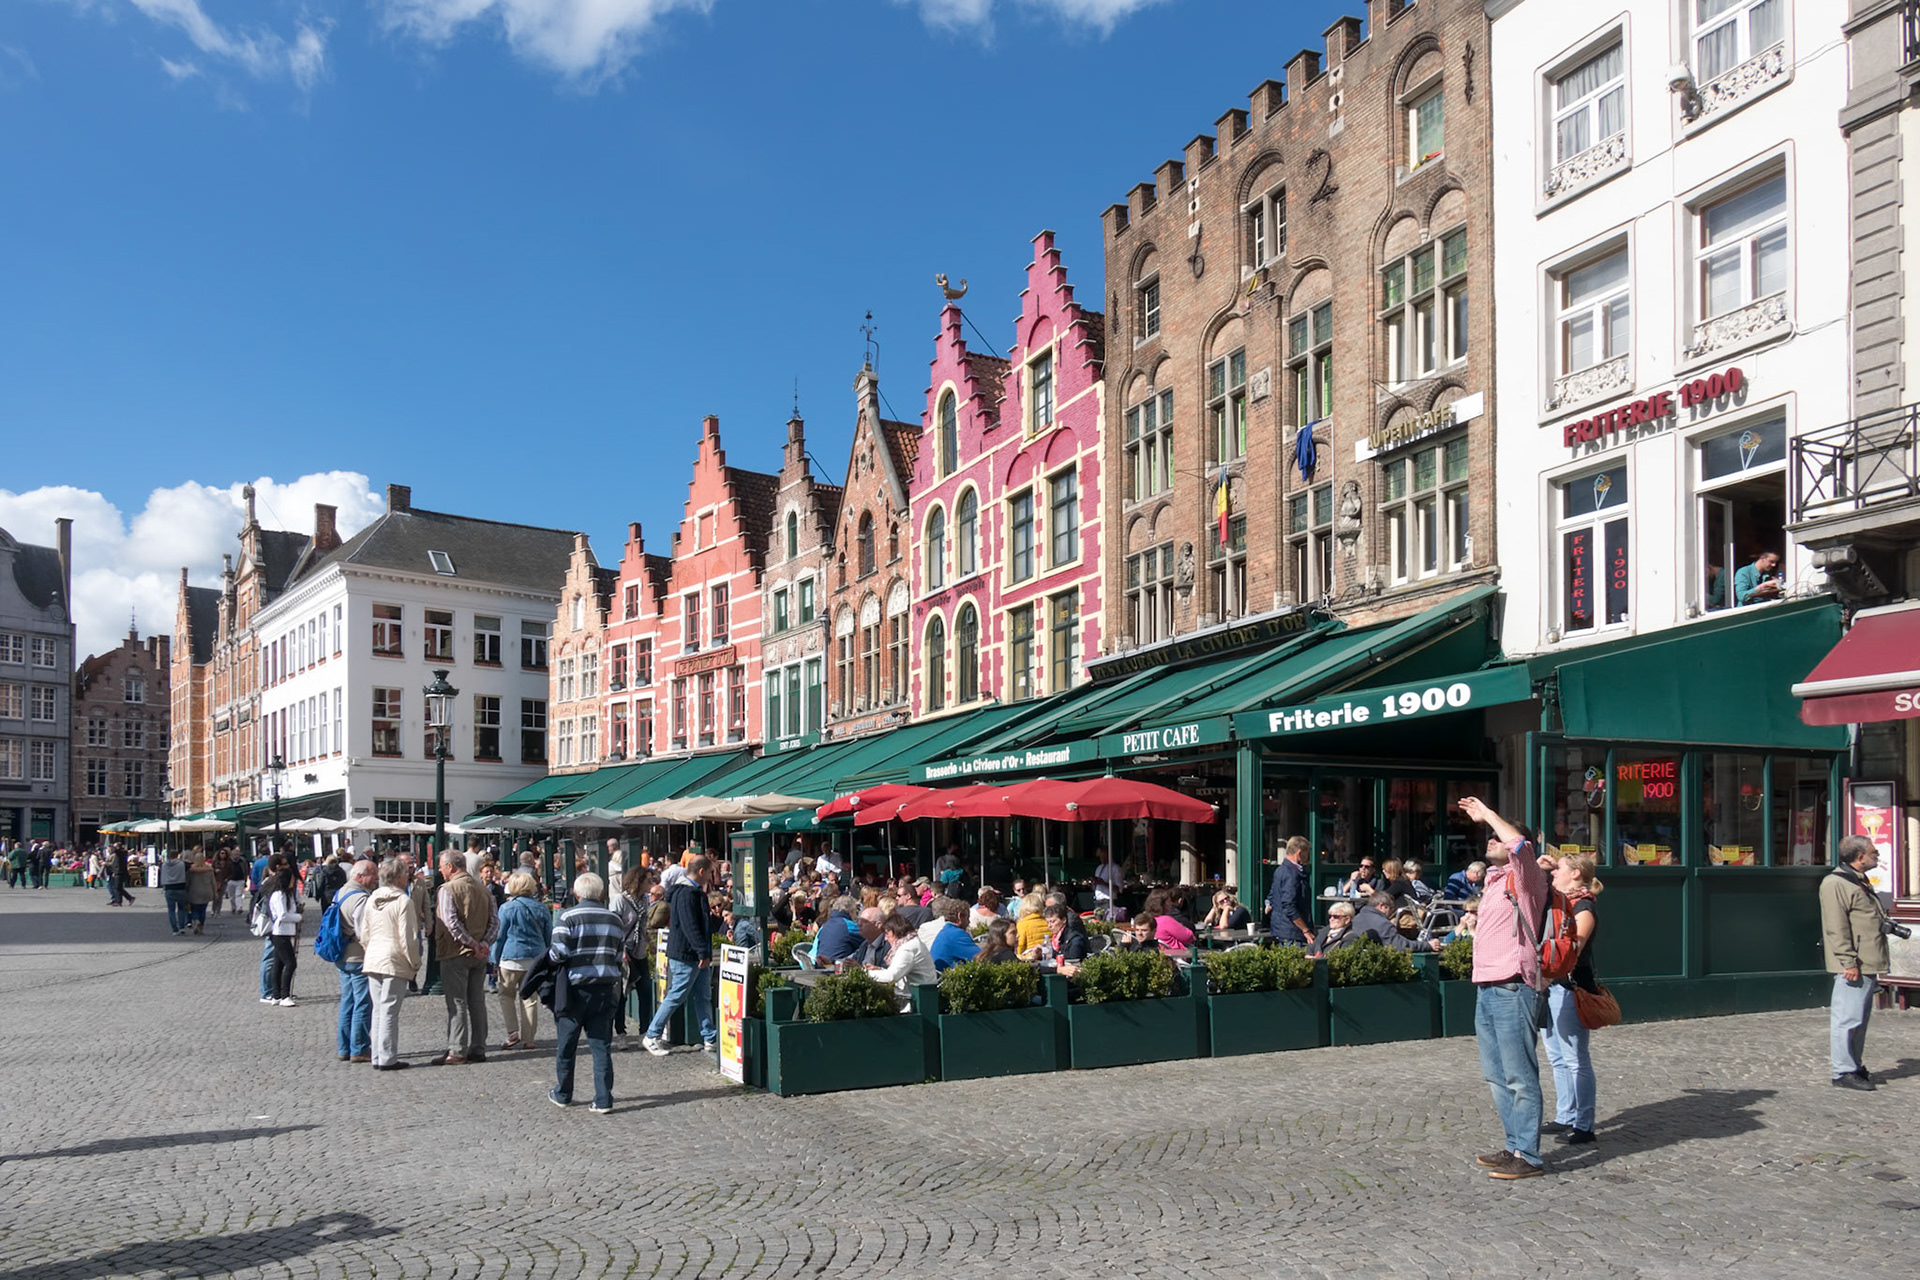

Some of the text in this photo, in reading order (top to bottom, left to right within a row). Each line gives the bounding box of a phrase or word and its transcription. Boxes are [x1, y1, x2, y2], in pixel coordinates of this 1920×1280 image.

[1564, 367, 1743, 447] FRITERIE 1900
[1368, 434, 1380, 450] AU
[1382, 420, 1416, 444] PETIT
[1573, 535, 1585, 618] FRITERIE
[1614, 548, 1626, 589] 1900
[1092, 649, 1168, 679] RESTAURANT
[1176, 642, 1196, 659] LA
[1265, 613, 1305, 635] D'OR
[1268, 682, 1471, 733] Friterie 1900
[1123, 724, 1200, 754] PETIT CAFE
[925, 762, 957, 779] Brasserie
[962, 761, 972, 773] La
[1001, 754, 1019, 769] d'Or
[1025, 746, 1070, 767] Restaurant
[1617, 762, 1675, 780] RITERIE
[1643, 781, 1674, 798] 1900
